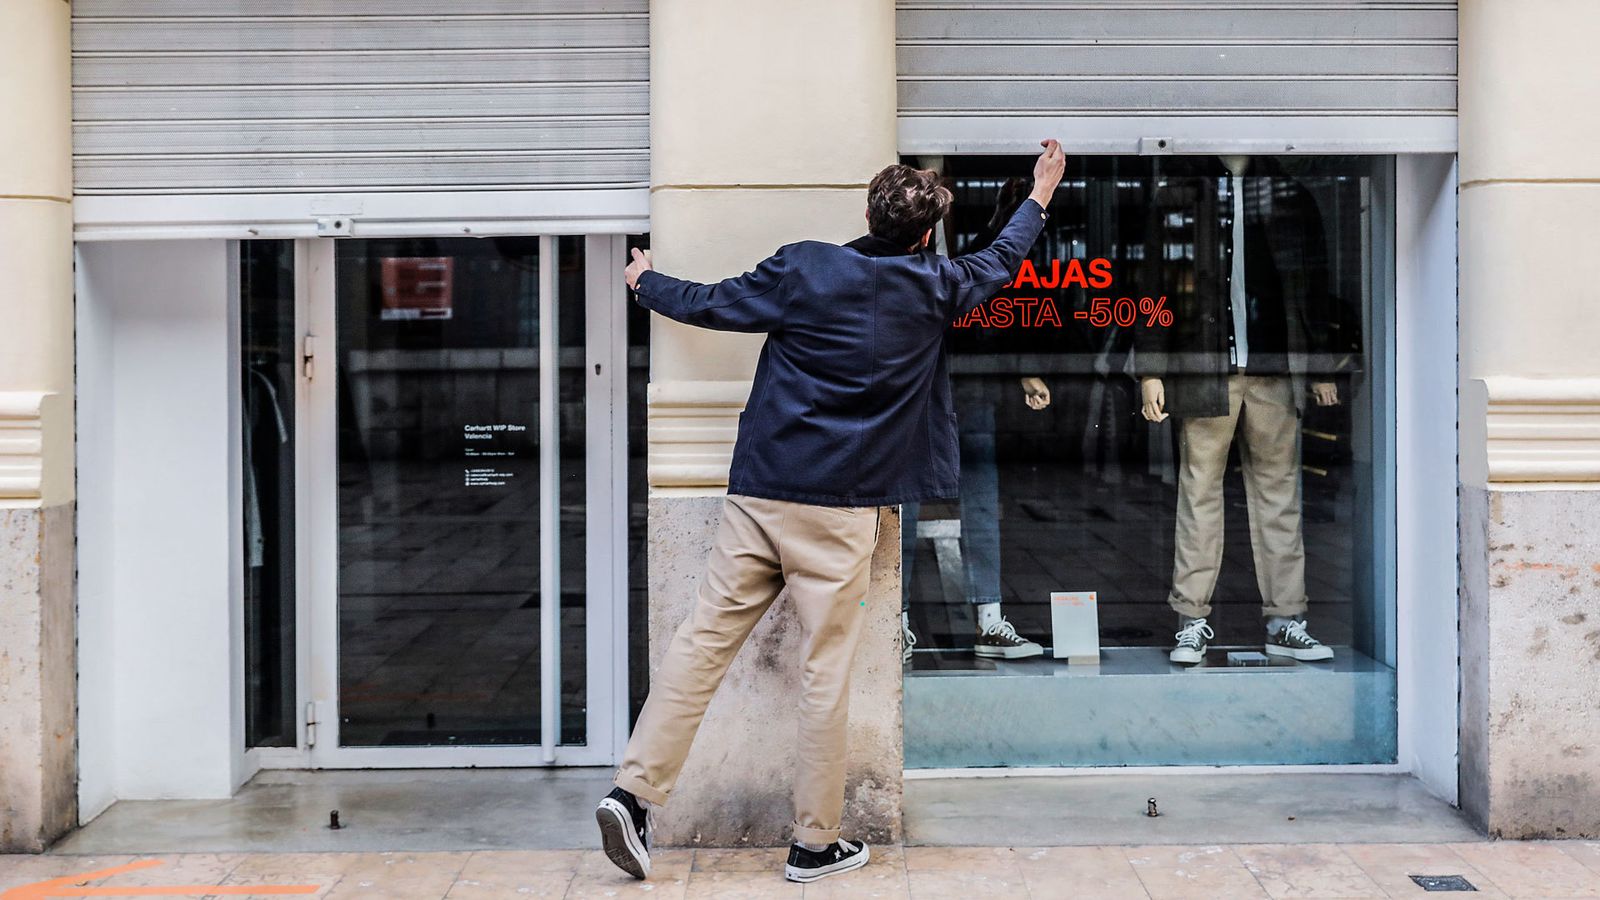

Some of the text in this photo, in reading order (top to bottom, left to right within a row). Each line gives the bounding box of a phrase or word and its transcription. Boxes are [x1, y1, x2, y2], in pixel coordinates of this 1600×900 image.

[1002, 257, 1113, 289] AJAS
[953, 296, 1173, 328] ASTA -50%
